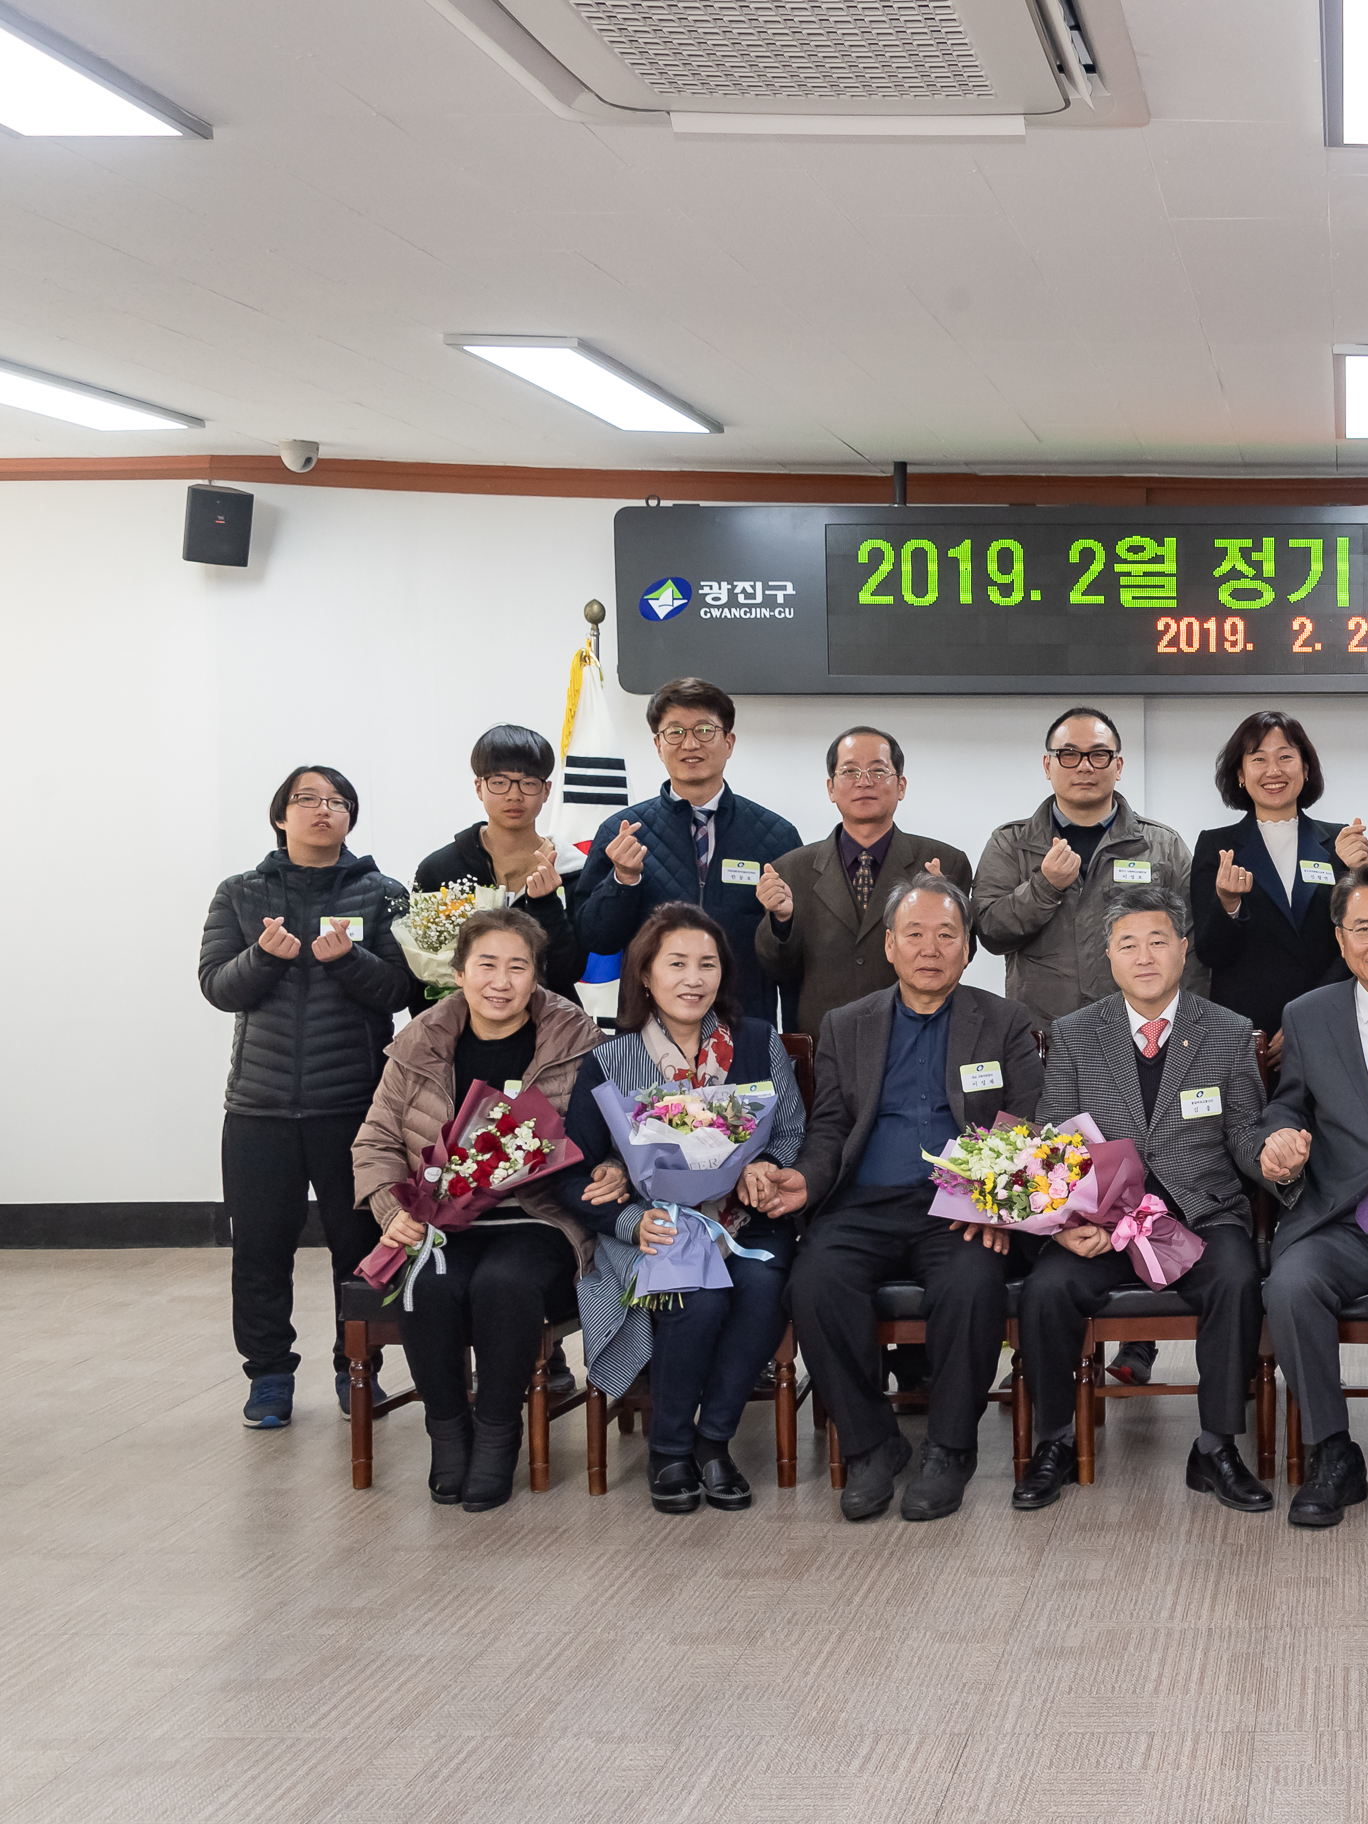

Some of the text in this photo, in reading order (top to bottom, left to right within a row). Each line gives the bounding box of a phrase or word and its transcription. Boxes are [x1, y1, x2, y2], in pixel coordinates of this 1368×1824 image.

[857, 538, 1042, 607] 2019.
[1068, 535, 1178, 609] 2월
[1212, 536, 1350, 610] 정기
[698, 580, 796, 606] 광진구
[699, 607, 795, 620] GWANGJIN-GU
[1156, 616, 1254, 654] 2019.
[1291, 615, 1323, 653] 2.
